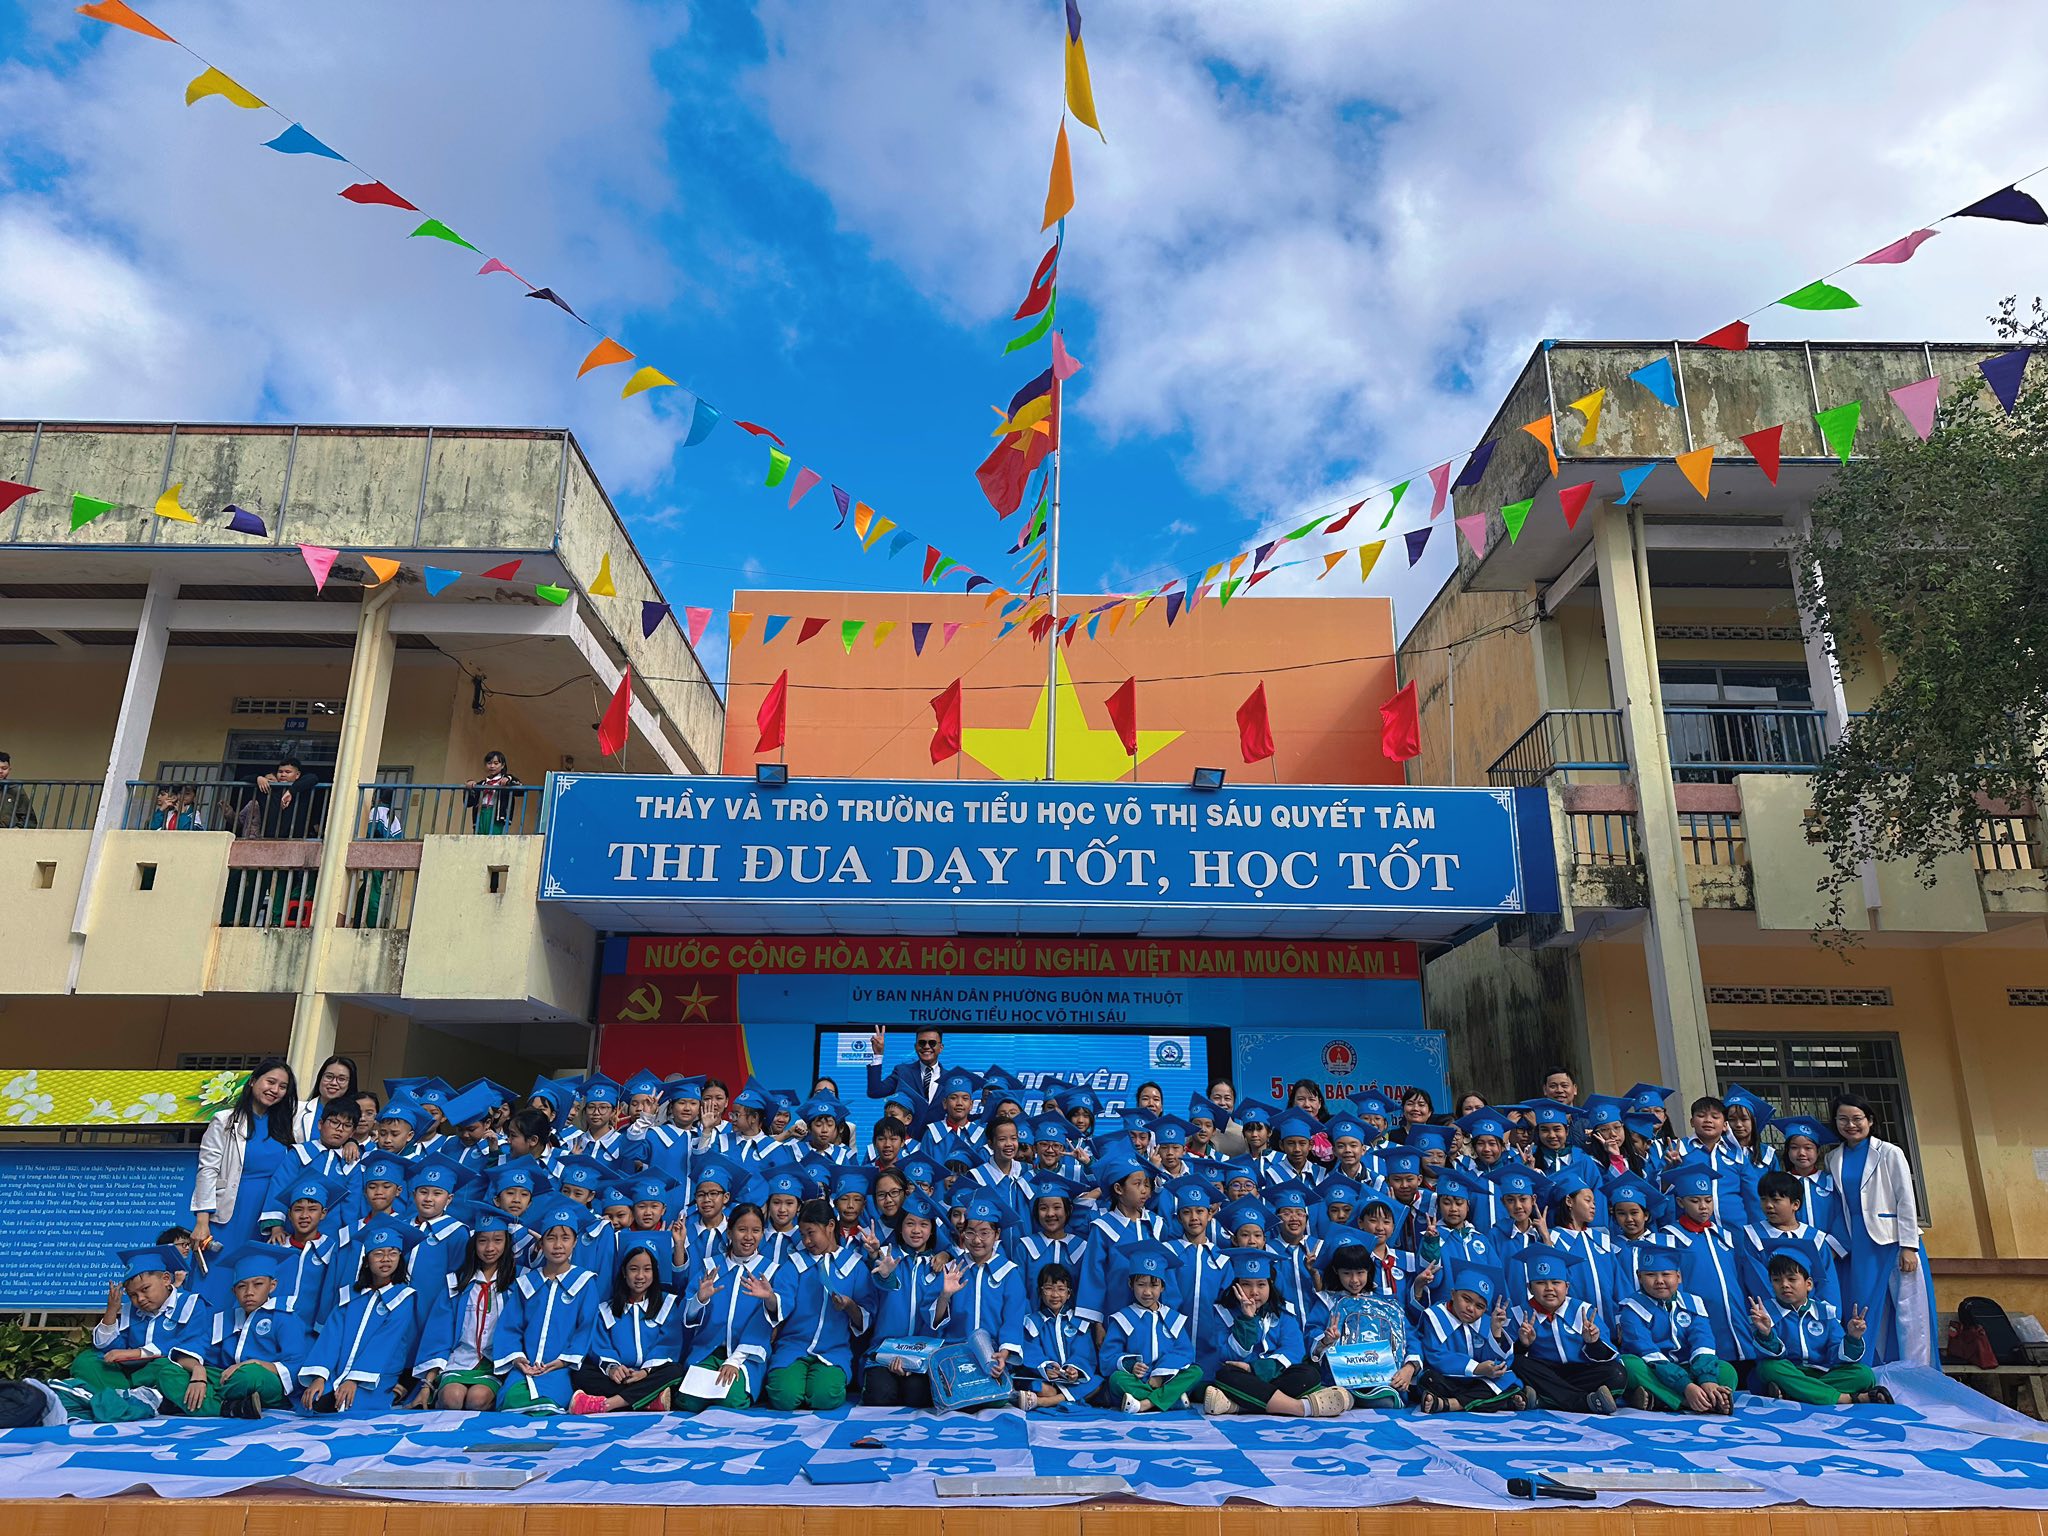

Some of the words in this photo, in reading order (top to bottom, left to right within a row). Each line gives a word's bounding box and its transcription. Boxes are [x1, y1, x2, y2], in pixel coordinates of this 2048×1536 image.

[636, 788, 714, 819] THẦY
[725, 793, 761, 819] VÀ
[772, 794, 828, 821] TRÒ
[838, 795, 953, 822] TRƯỜNG
[964, 791, 1027, 823] TIỂU
[1038, 802, 1095, 830] HỌC
[1105, 797, 1141, 825] VÕ
[1151, 804, 1196, 832] THỊ
[1207, 799, 1261, 827] SÁU
[1272, 799, 1365, 828] QUYẾT
[1375, 802, 1435, 829] TÂM
[608, 843, 721, 882] THI
[740, 846, 871, 883] ĐUA
[891, 847, 1018, 894] DẠY
[1037, 835, 1170, 895] TỐT,
[1189, 850, 1319, 898] HỌC
[1339, 839, 1460, 891] TỐT
[645, 939, 720, 968] NƯỚC
[728, 939, 806, 974] CỘNG
[815, 940, 869, 968] HÒA
[878, 942, 912, 969] XÃ
[921, 941, 965, 975] HỘI
[973, 940, 1026, 970] CHỦ
[1035, 943, 1115, 971] NGHĨA
[1123, 944, 1171, 977] VIỆT
[1180, 950, 1235, 972] NAM
[1244, 944, 1319, 973] MUÔN
[1328, 945, 1384, 973] NĂM
[852, 986, 873, 1002] ỦY
[877, 989, 906, 1001] BAN
[911, 988, 953, 1002] NHÂN
[958, 988, 988, 1002] DÂN
[993, 988, 1057, 1003] PHƯỜNG
[1061, 989, 1104, 1004] BUÔN
[1108, 991, 1129, 1004] MA
[1133, 991, 1183, 1007] THUỘT
[909, 1006, 971, 1022] TRƯỜNG
[976, 1005, 1007, 1022] TIỂU
[1011, 1009, 1043, 1024] HỌC
[1046, 1008, 1067, 1023] VÕ
[1097, 1008, 1127, 1023] SÁU
[1271, 1076, 1284, 1099] 5
[1325, 1081, 1355, 1099] BÁC
[864, 1423, 999, 1443] 85
[1058, 1426, 1194, 1443] 86
[1633, 1422, 1782, 1444] 89
